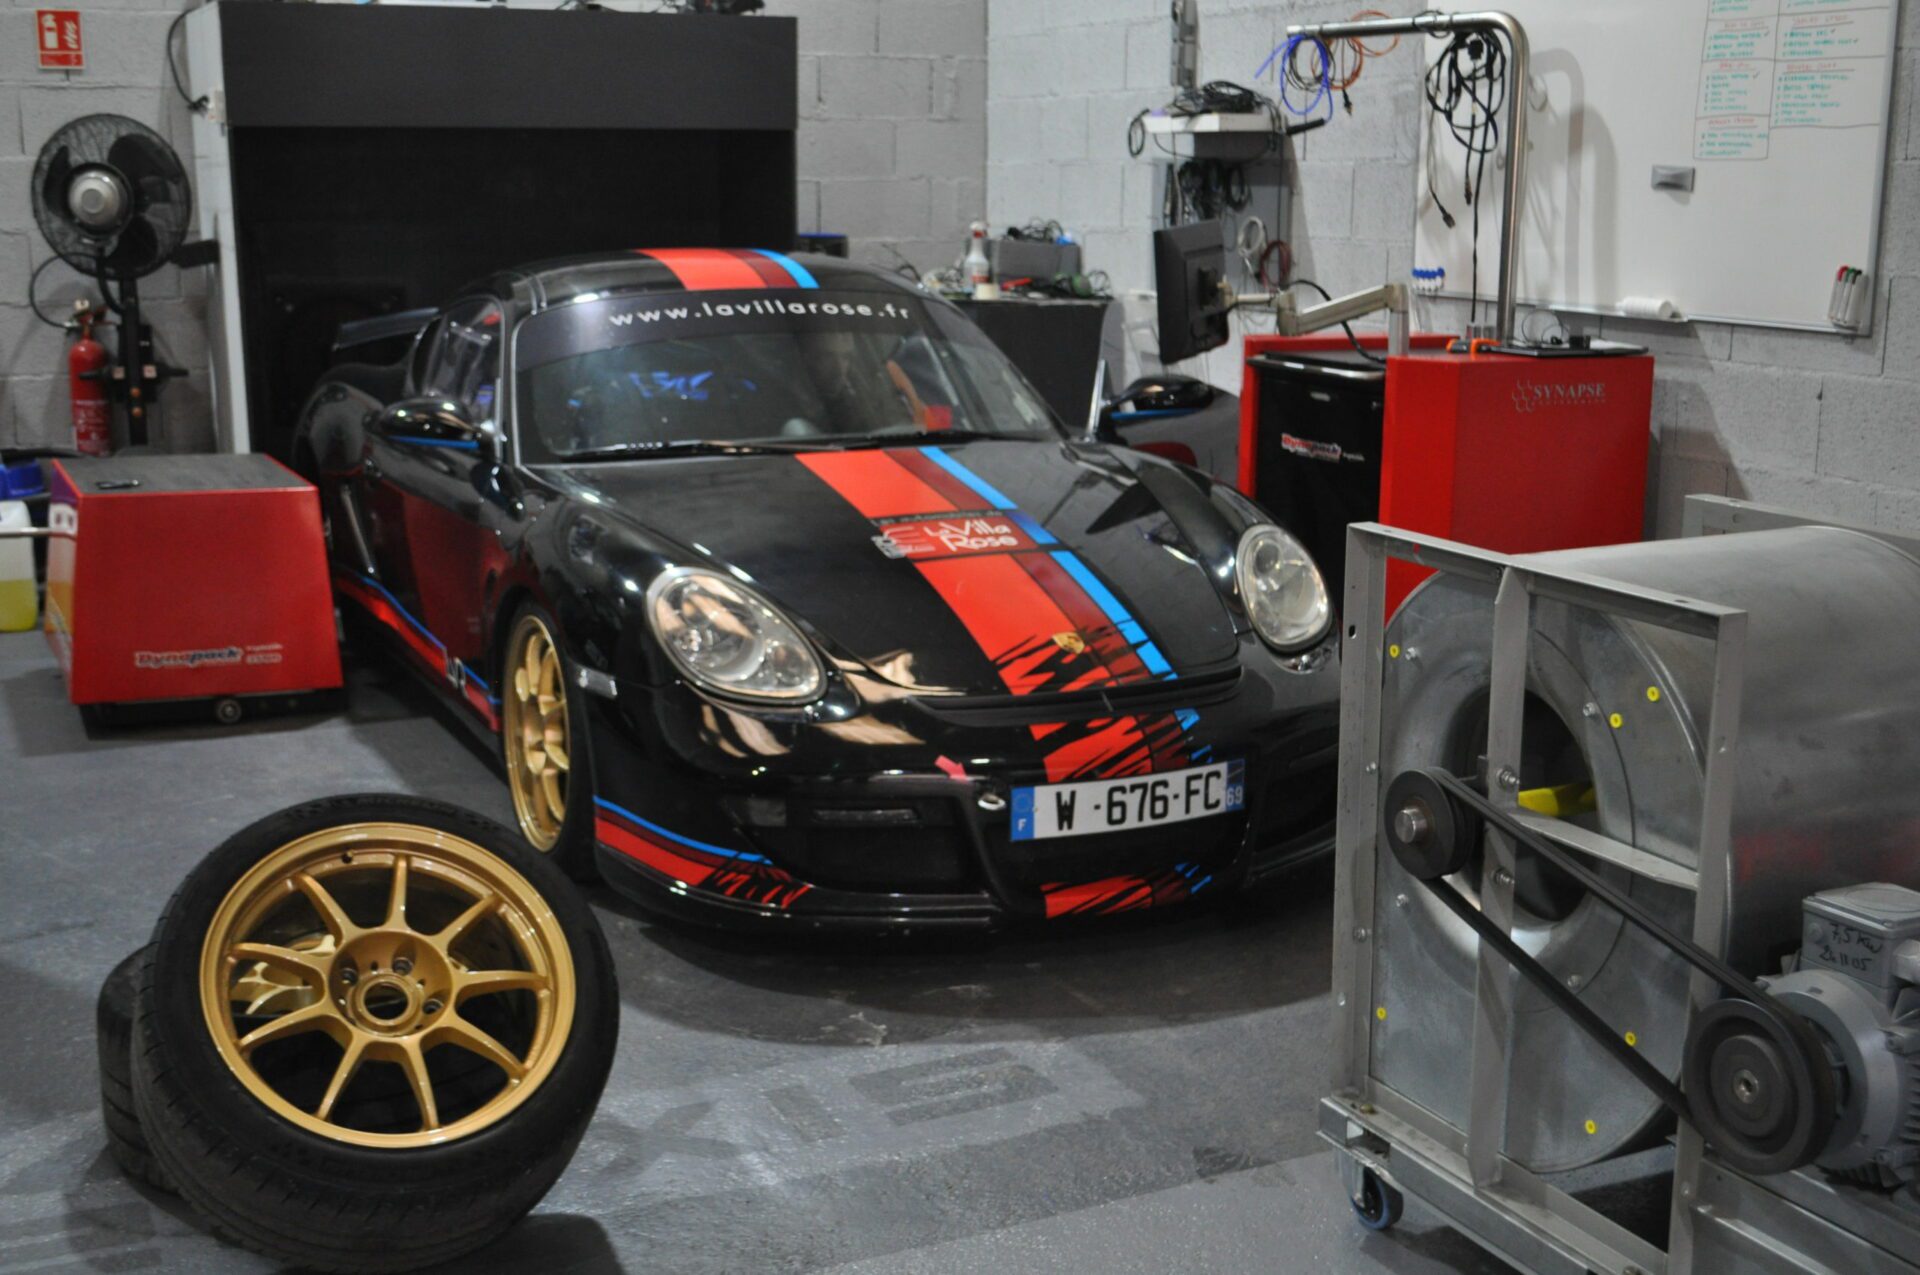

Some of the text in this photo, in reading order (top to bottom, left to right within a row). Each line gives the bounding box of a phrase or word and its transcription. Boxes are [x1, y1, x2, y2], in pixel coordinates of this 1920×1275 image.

[610, 299, 909, 326] www.lavillarose.fr
[1534, 383, 1605, 399] SYNAPSE
[939, 519, 1012, 536] Villa
[940, 533, 1018, 552] Rose
[1017, 818, 1027, 832] F
[1226, 785, 1244, 806] 69
